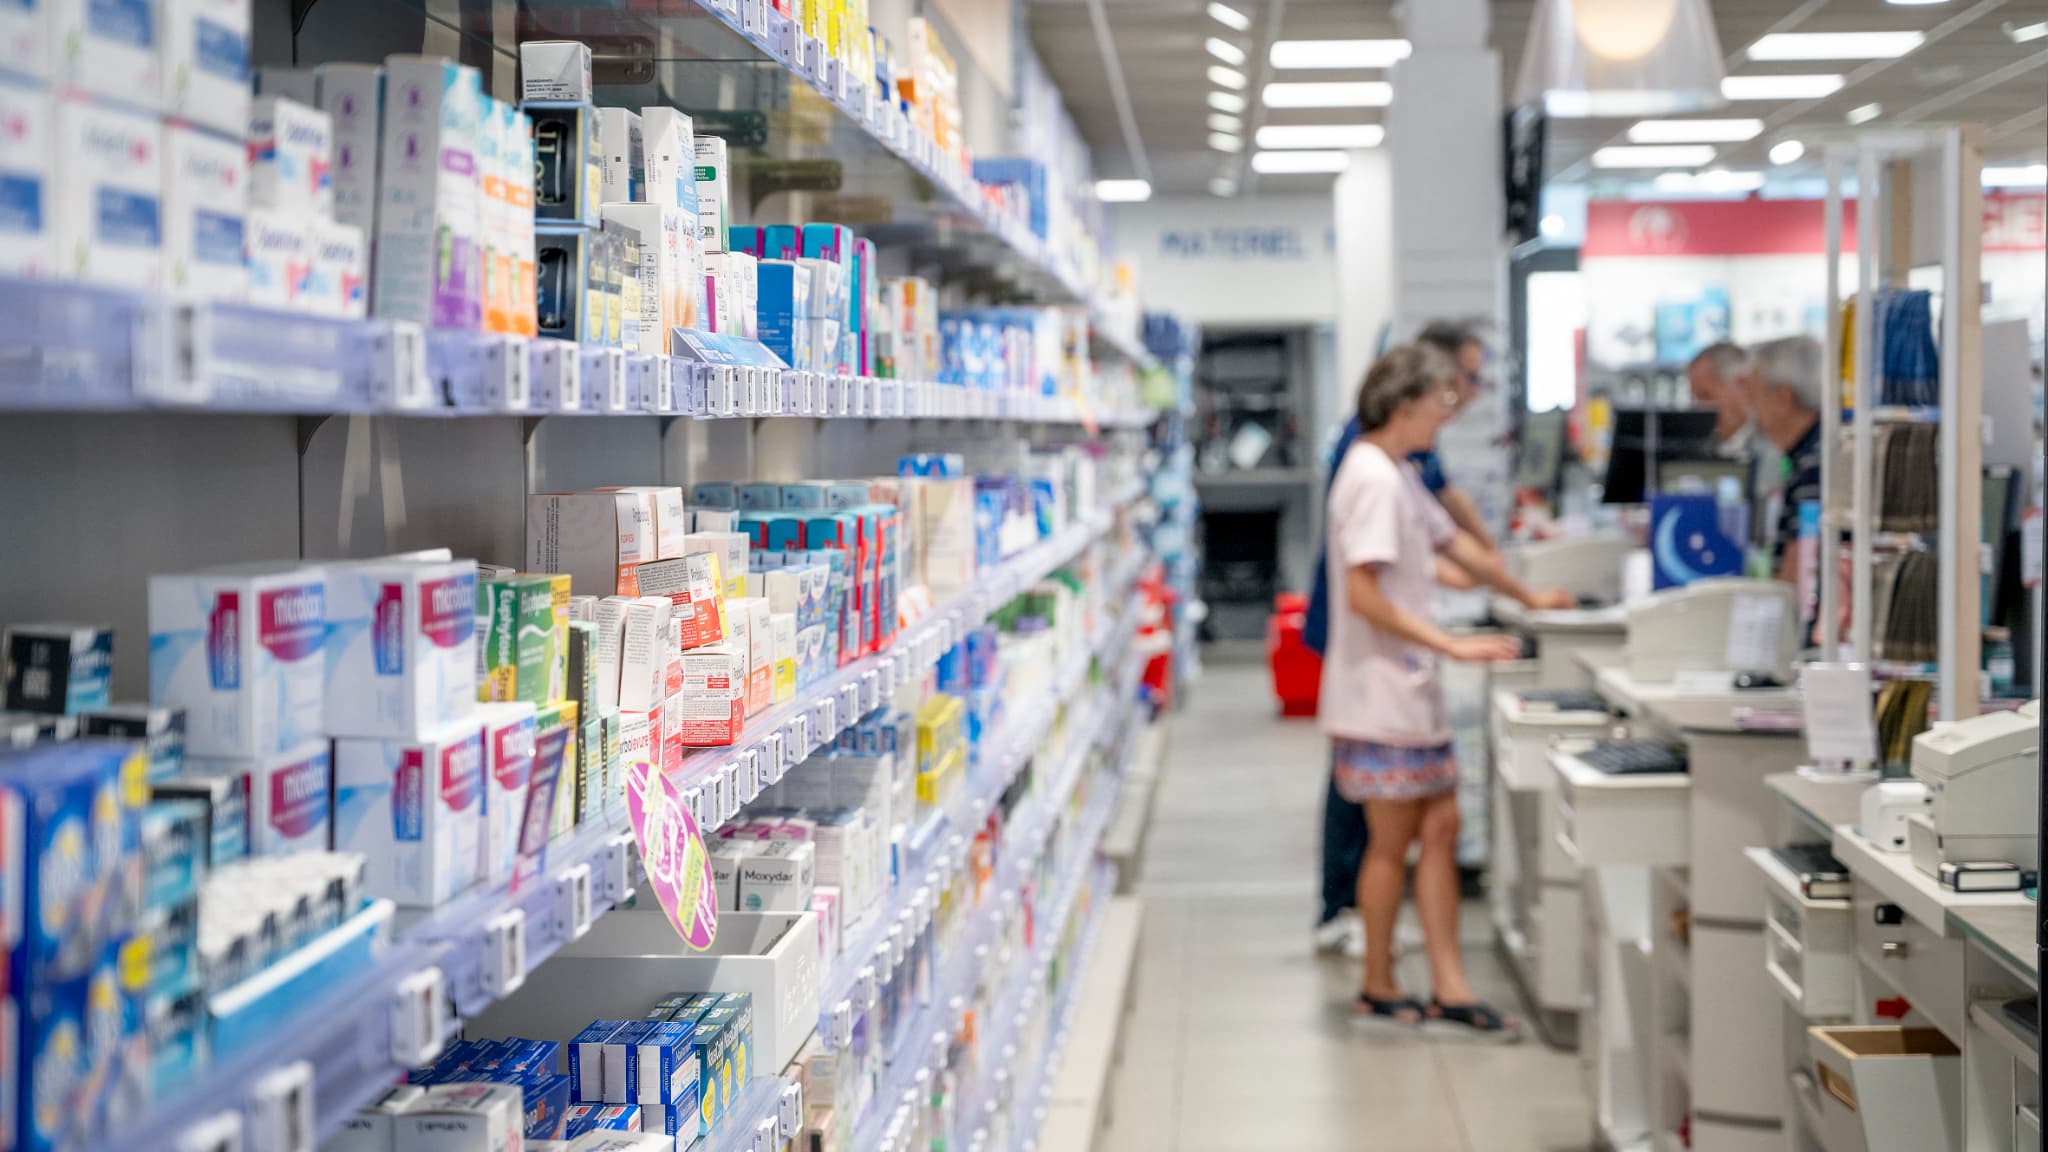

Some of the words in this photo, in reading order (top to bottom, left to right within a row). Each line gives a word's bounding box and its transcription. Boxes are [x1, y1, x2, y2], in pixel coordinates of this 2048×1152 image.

[273, 593, 321, 626] microlax
[432, 580, 473, 615] microlax
[497, 589, 516, 667] Euphytose
[283, 764, 324, 803] microlax
[744, 870, 793, 882] Moxydar
